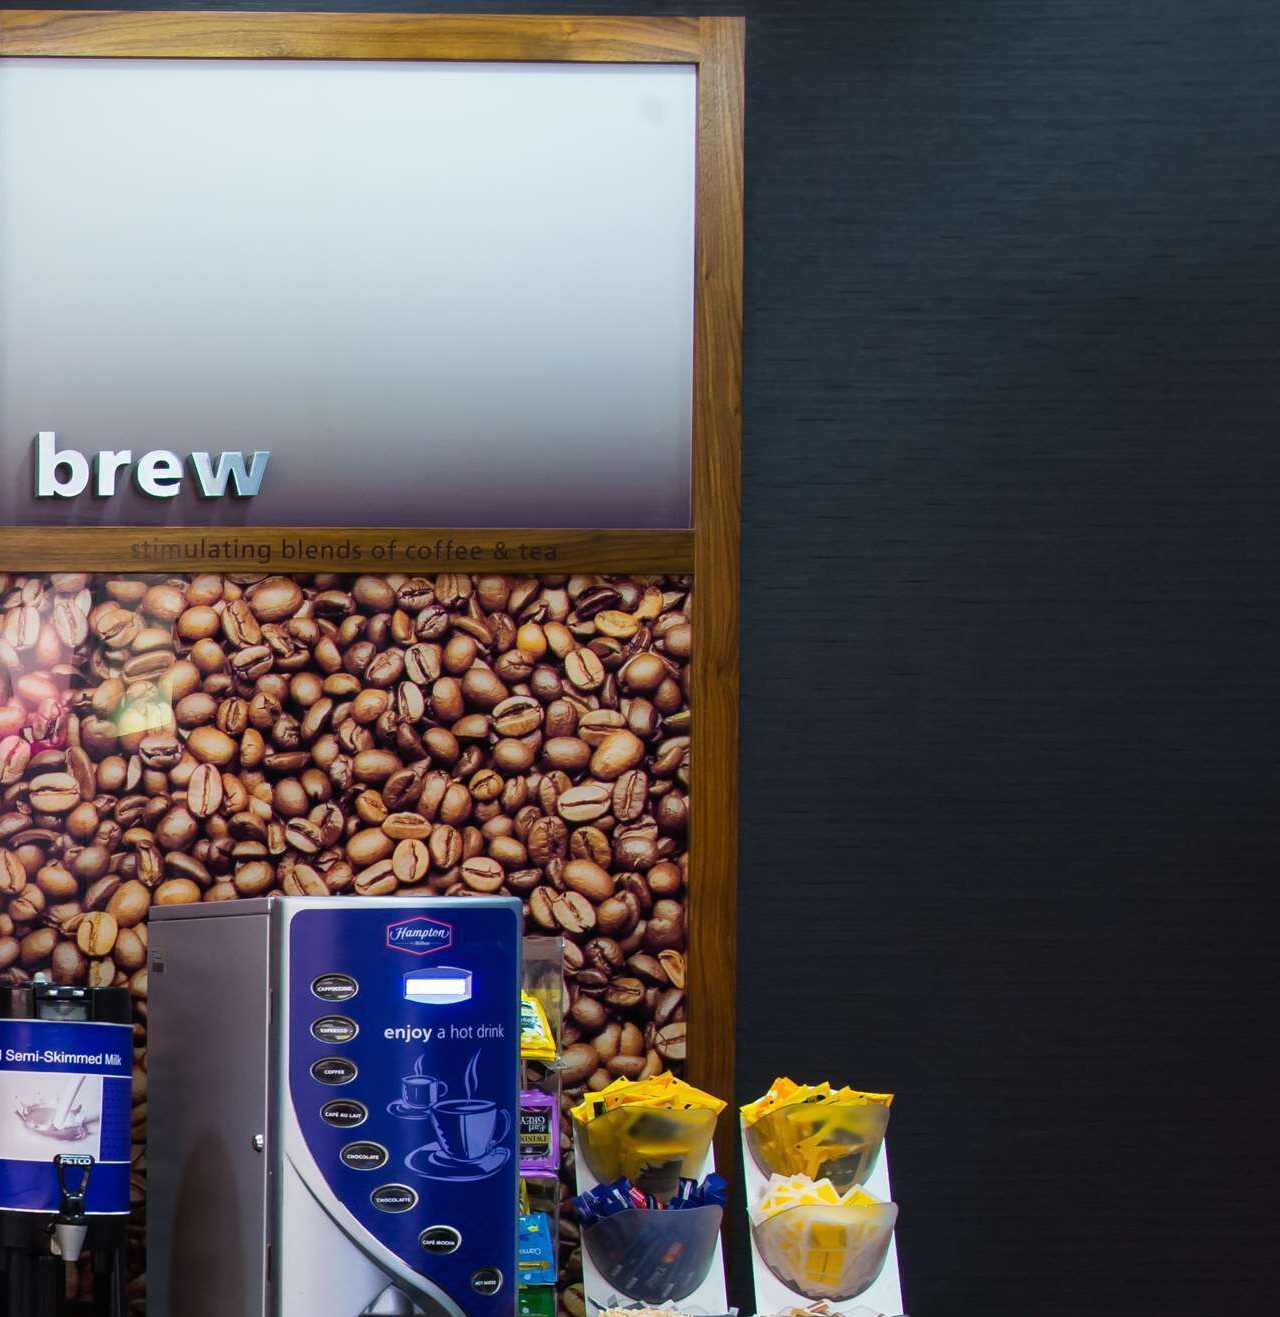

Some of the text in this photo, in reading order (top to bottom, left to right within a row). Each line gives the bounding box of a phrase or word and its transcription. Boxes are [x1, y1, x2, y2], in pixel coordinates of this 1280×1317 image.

[34, 430, 271, 498] brew
[131, 538, 557, 565] stimulating blends of coffee & tea
[390, 926, 450, 941] Hampton
[384, 1024, 505, 1043] enjoy a hot drink
[5, 1049, 103, 1065] Semi-Skimmed
[104, 1053, 122, 1066] Milk
[60, 1157, 91, 1165] FETCO
